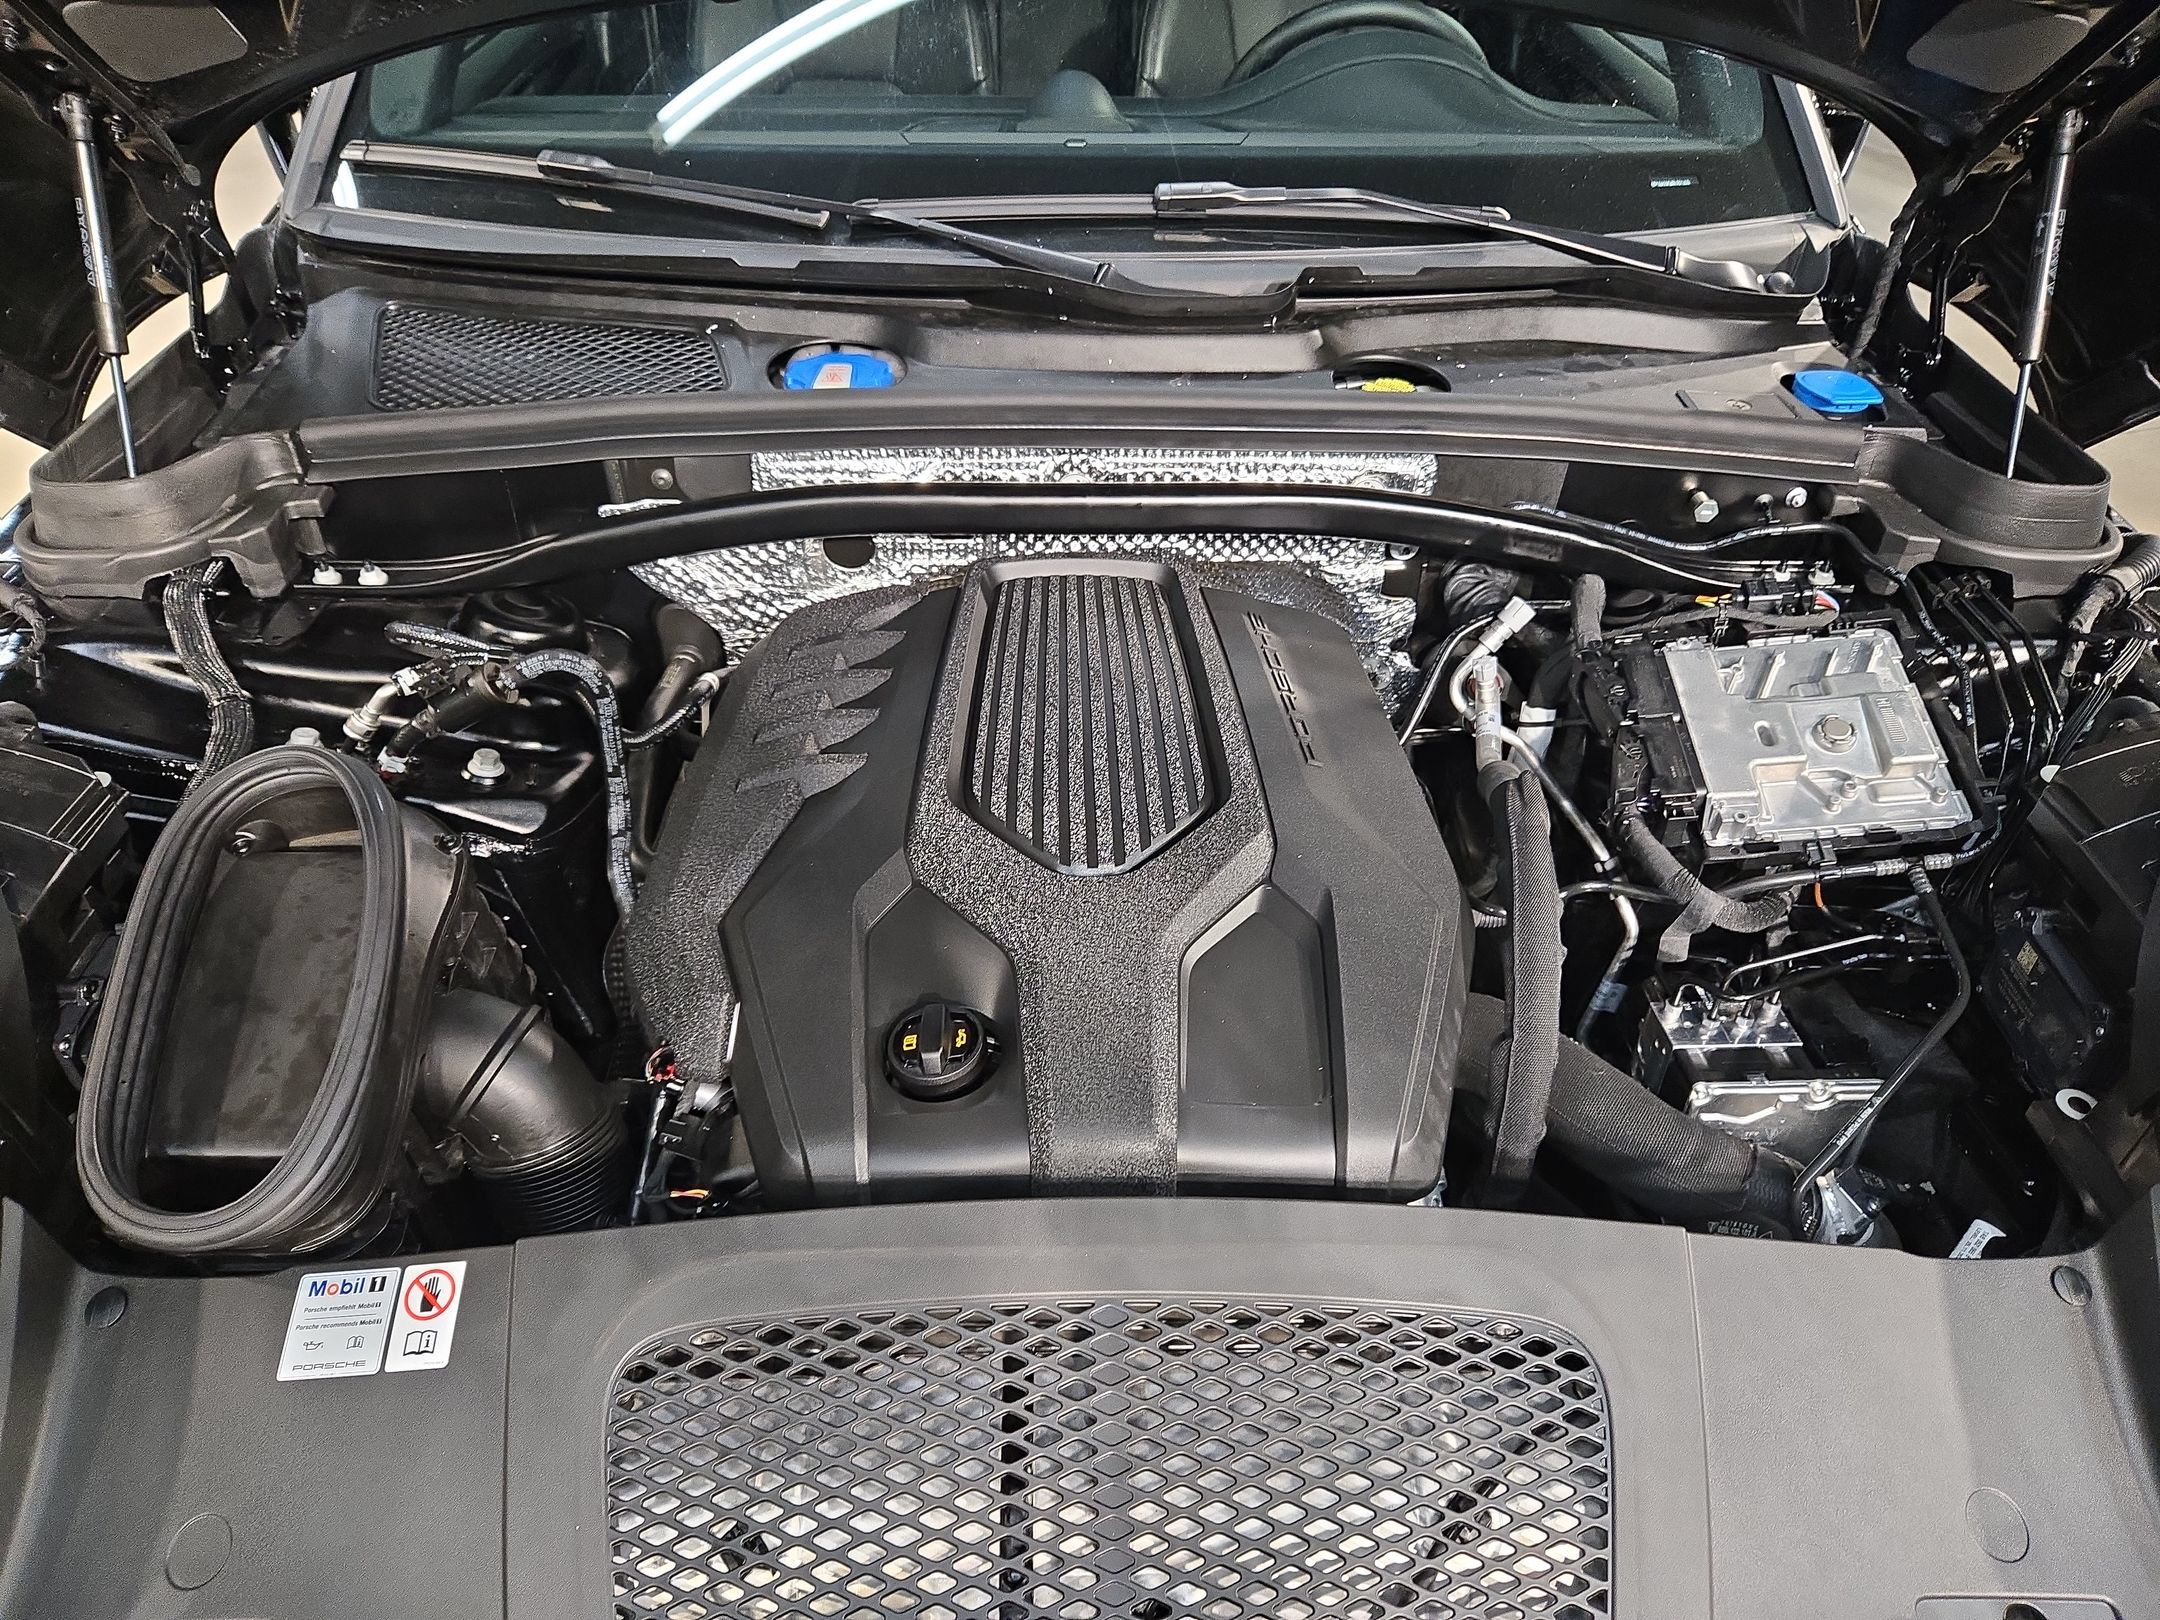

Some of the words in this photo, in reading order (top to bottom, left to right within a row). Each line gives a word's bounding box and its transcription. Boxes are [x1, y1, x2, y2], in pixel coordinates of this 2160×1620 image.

[1247, 610, 1324, 768] PORSCHE
[308, 1277, 366, 1297] Mobil
[371, 1276, 385, 1292] 1
[303, 1305, 328, 1313] Porsche
[328, 1304, 356, 1312] empfiehlt
[295, 1323, 319, 1331] Porsche
[320, 1321, 358, 1329] recommends
[292, 1360, 367, 1371] PORSCHE
